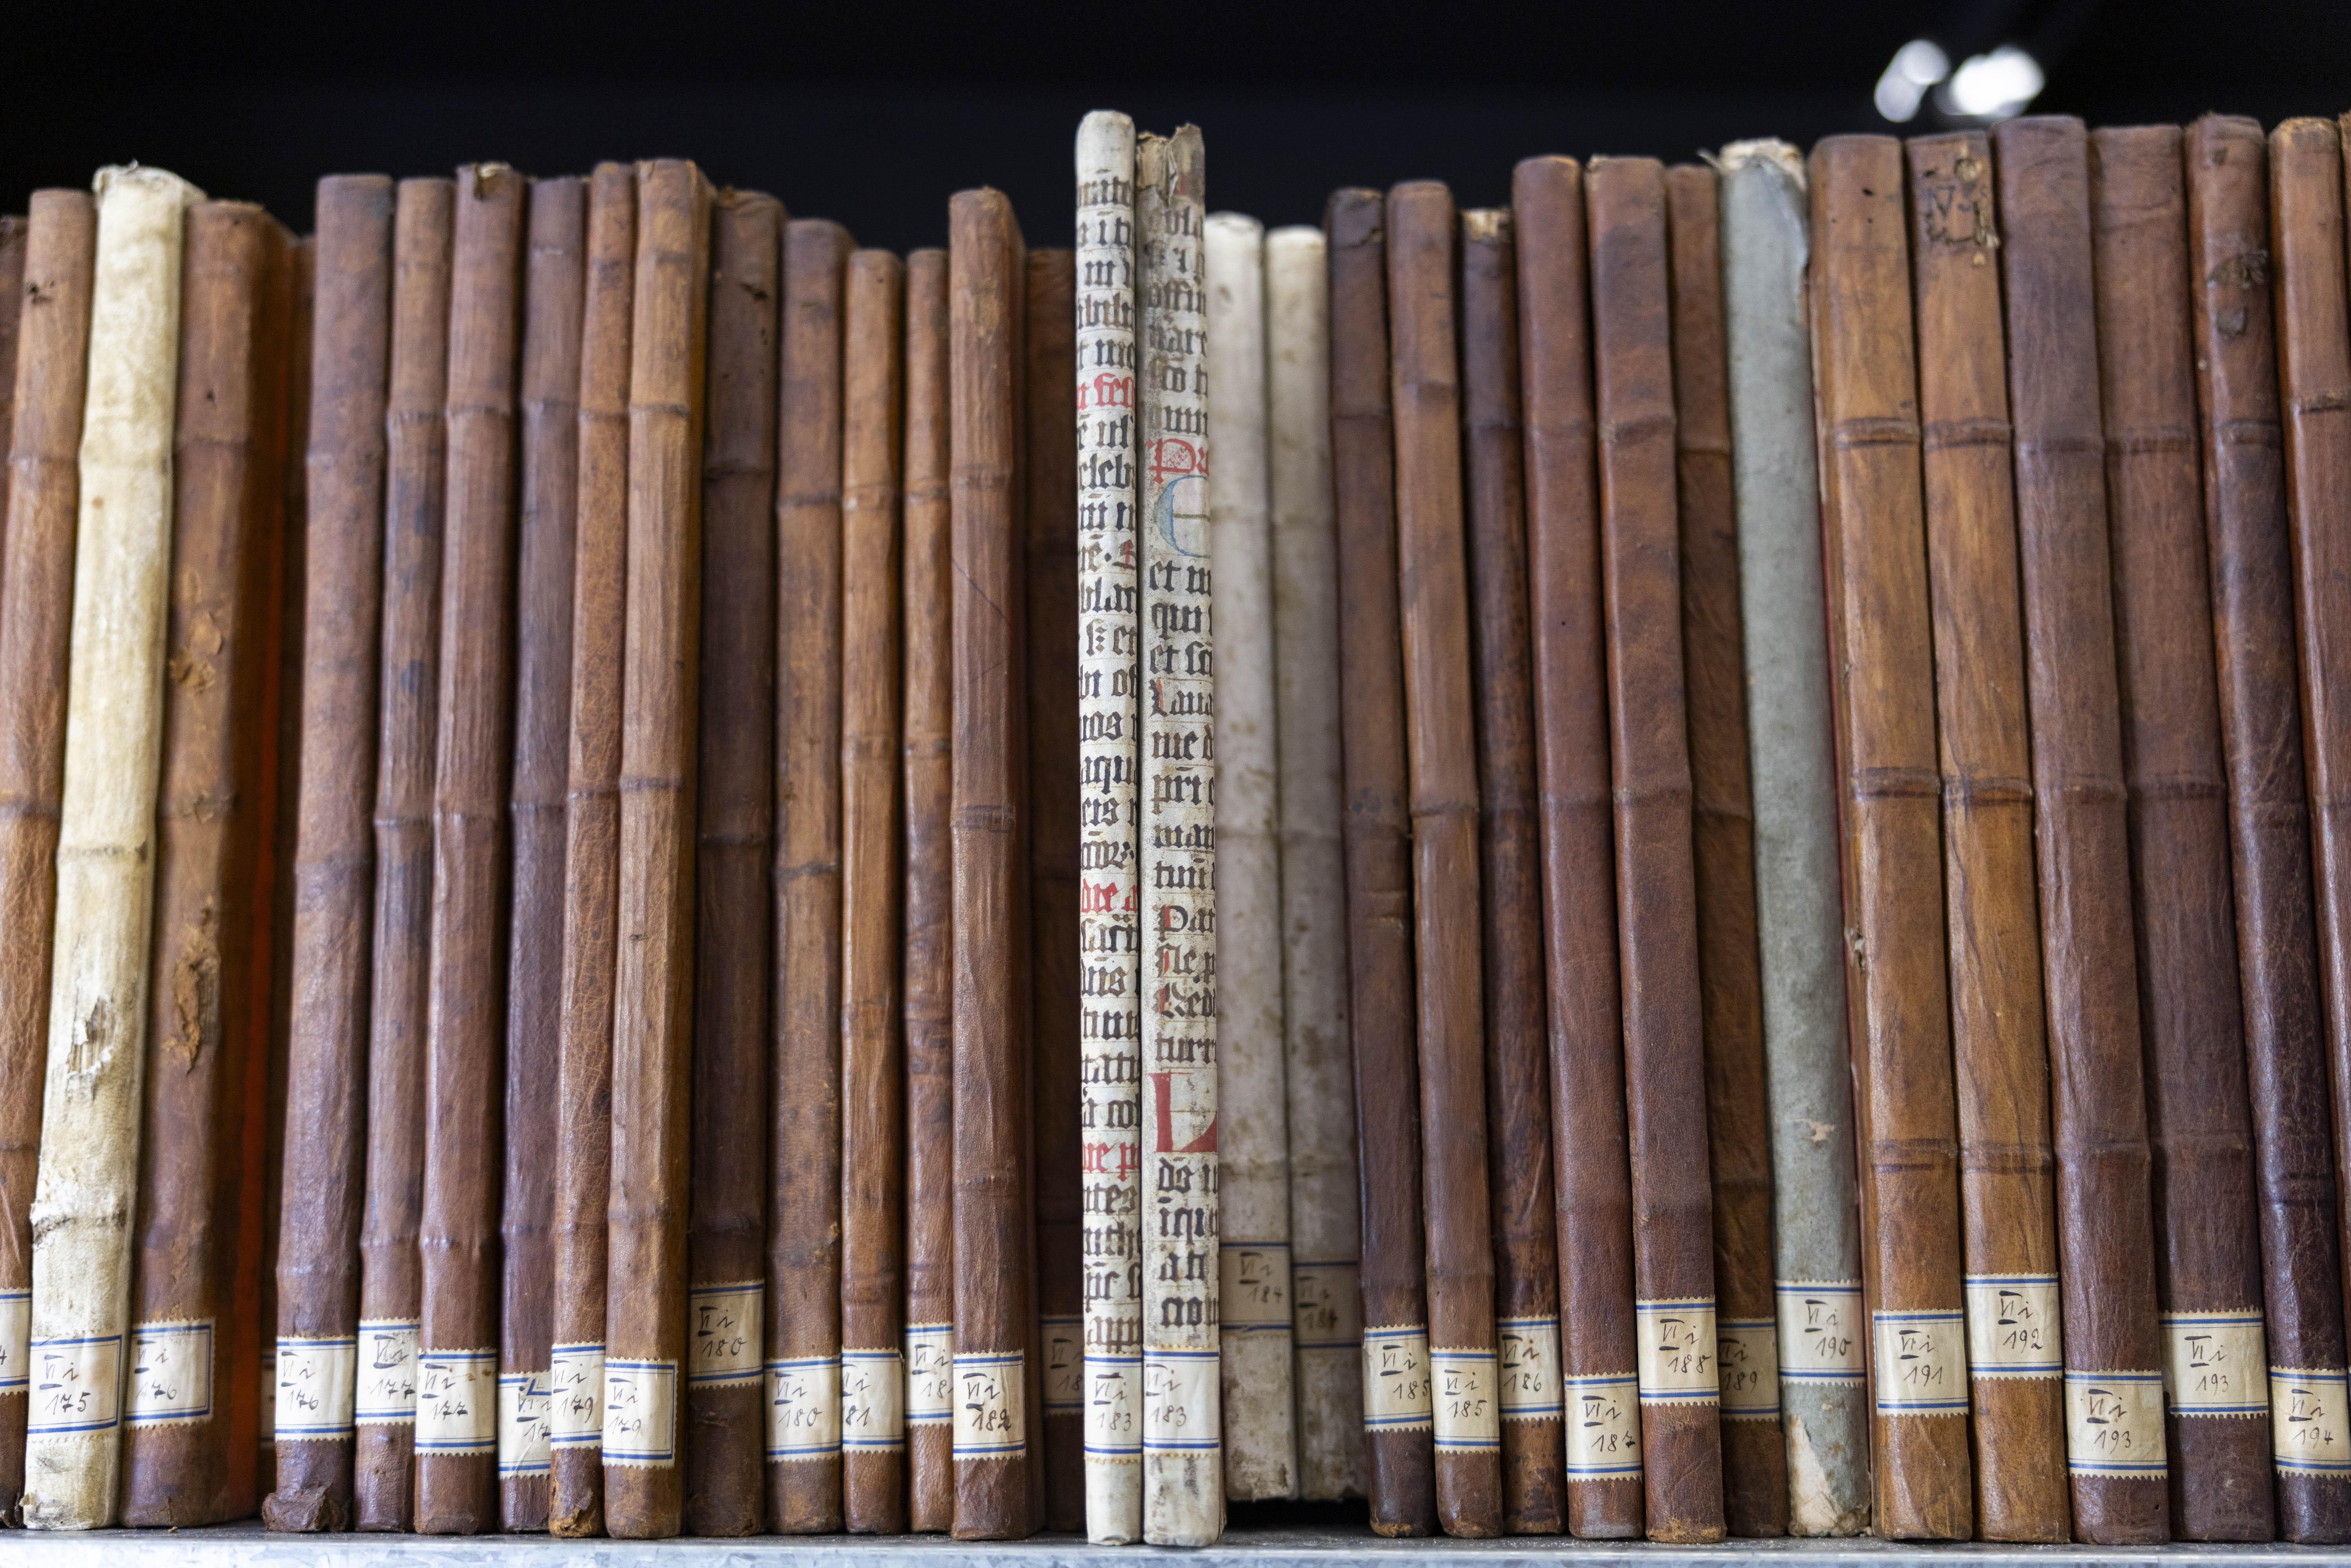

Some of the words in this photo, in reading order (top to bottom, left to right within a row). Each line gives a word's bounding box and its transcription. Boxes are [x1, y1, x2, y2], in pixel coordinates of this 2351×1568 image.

[702, 1337, 747, 1357] 180
[1815, 1336, 1851, 1358] 190
[2003, 1328, 2043, 1354] 192
[1668, 1354, 1711, 1374] 188
[1503, 1373, 1542, 1392] 186
[1724, 1371, 1757, 1393] 189
[1904, 1365, 1943, 1387] 191
[2195, 1373, 2228, 1396] 193
[136, 1379, 177, 1400] 176
[370, 1379, 415, 1399] 177
[920, 1380, 953, 1398] 18
[1393, 1379, 1429, 1399] 185
[45, 1392, 91, 1415] 175
[287, 1390, 319, 1410] 176
[432, 1401, 468, 1420] 177
[557, 1395, 594, 1424] 179
[1447, 1400, 1487, 1418] 185
[778, 1407, 822, 1427] 180
[842, 1405, 870, 1427] 81
[972, 1408, 1012, 1431] 182
[1096, 1412, 1132, 1431] 183
[1149, 1405, 1187, 1427] 183
[609, 1415, 641, 1443] 179
[2291, 1427, 2334, 1448] 194
[1592, 1430, 1636, 1452] 187
[2094, 1429, 2131, 1454] 193
